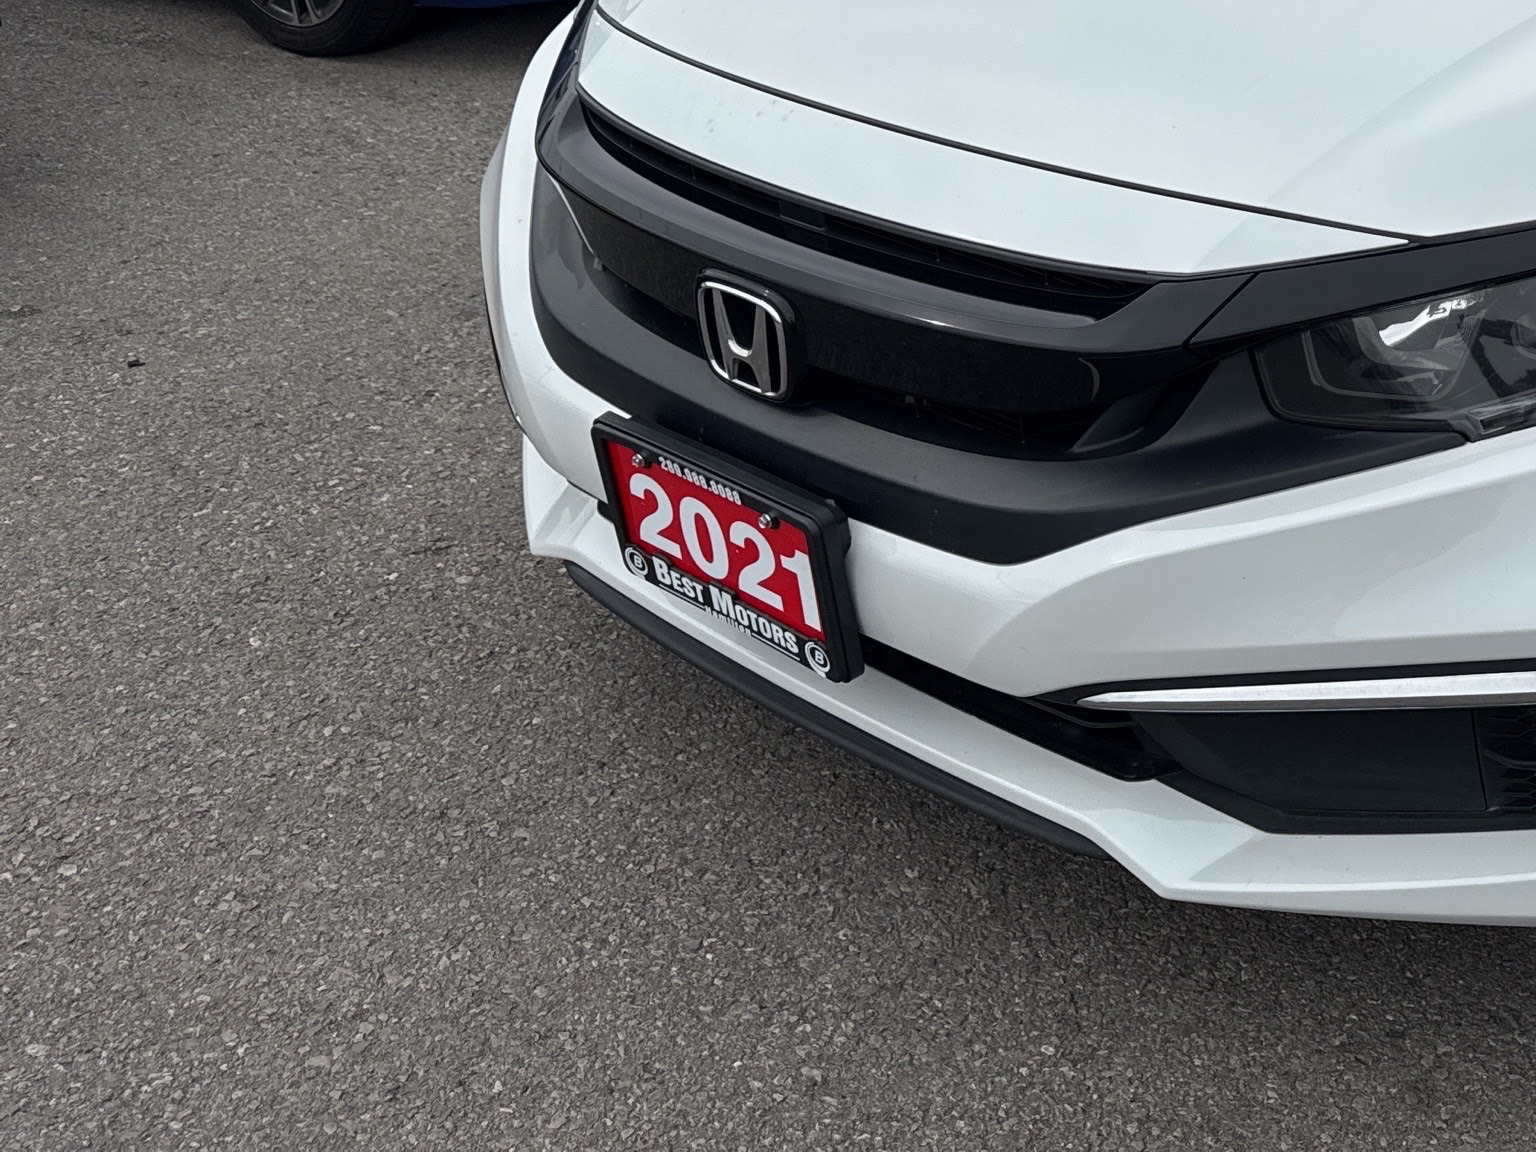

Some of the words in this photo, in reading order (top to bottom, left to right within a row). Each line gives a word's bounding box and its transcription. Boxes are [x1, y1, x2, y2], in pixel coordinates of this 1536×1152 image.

[629, 472, 822, 633] 2021
[651, 556, 705, 603] BEST
[708, 584, 800, 654] MOTORS
